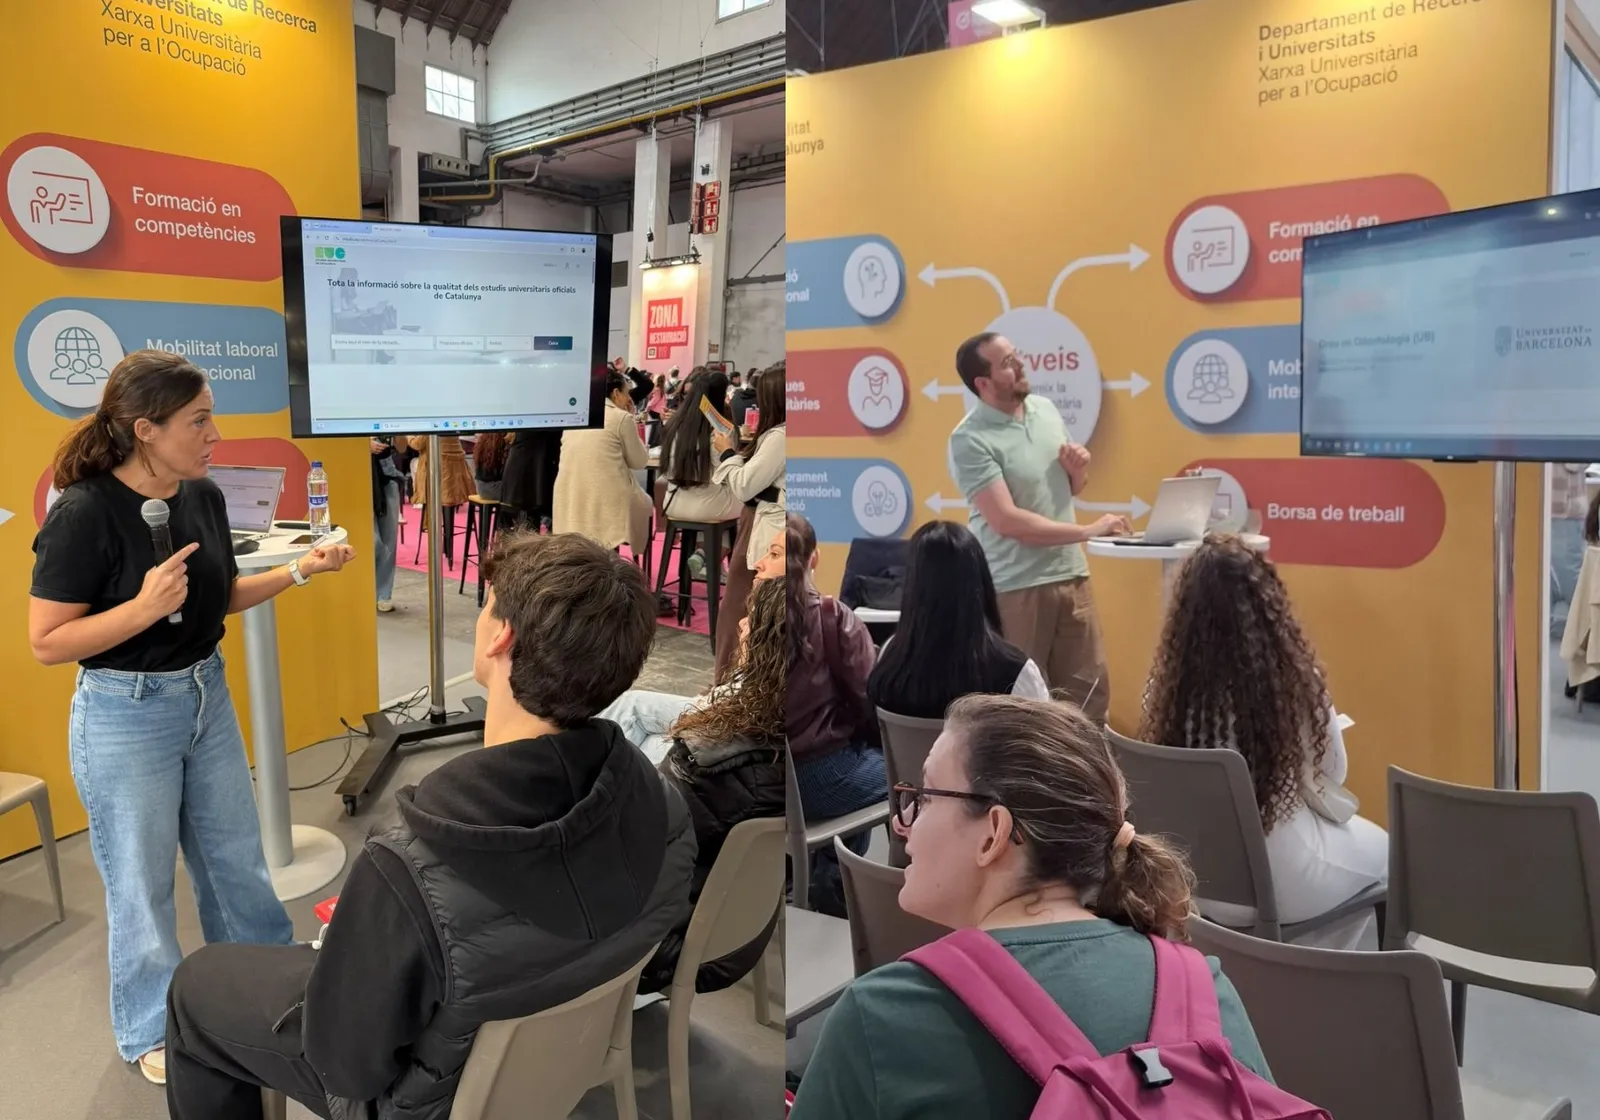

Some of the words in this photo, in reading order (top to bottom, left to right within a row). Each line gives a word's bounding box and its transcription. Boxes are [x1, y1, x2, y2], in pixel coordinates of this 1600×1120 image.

[253, 0, 317, 33] Recerca
[1259, 8, 1376, 41] Departament
[1383, 3, 1406, 19] de
[101, 0, 155, 31] Xarxa
[160, 15, 262, 60] Universitària
[103, 27, 134, 47] per
[140, 38, 152, 53] a
[1258, 46, 1264, 62] i
[1269, 30, 1376, 60] Universitats
[1258, 64, 1305, 83] Xarxa
[1310, 43, 1418, 74] Universitària
[1258, 87, 1286, 107] per
[1290, 85, 1300, 98] a
[132, 186, 217, 215] Formació
[221, 203, 242, 217] en
[135, 217, 256, 244] competències
[1269, 213, 1353, 239] Formació
[327, 279, 345, 288] Tota
[347, 279, 356, 288] la
[357, 280, 399, 289] informació
[400, 281, 422, 290] sobre
[423, 282, 431, 290] la
[433, 282, 462, 293] qualitat
[481, 284, 506, 292] estudis
[508, 285, 550, 293] universitaris
[552, 285, 576, 294] oficials
[434, 292, 443, 300] de
[445, 292, 482, 301] Catalunya
[650, 304, 678, 328] ZONA
[146, 338, 222, 356] Mobilitat
[226, 340, 278, 357] laboral
[1516, 336, 1592, 351] BARCELONA
[1267, 503, 1317, 520] Borsa
[1321, 503, 1343, 520] de
[1349, 505, 1405, 522] treball
